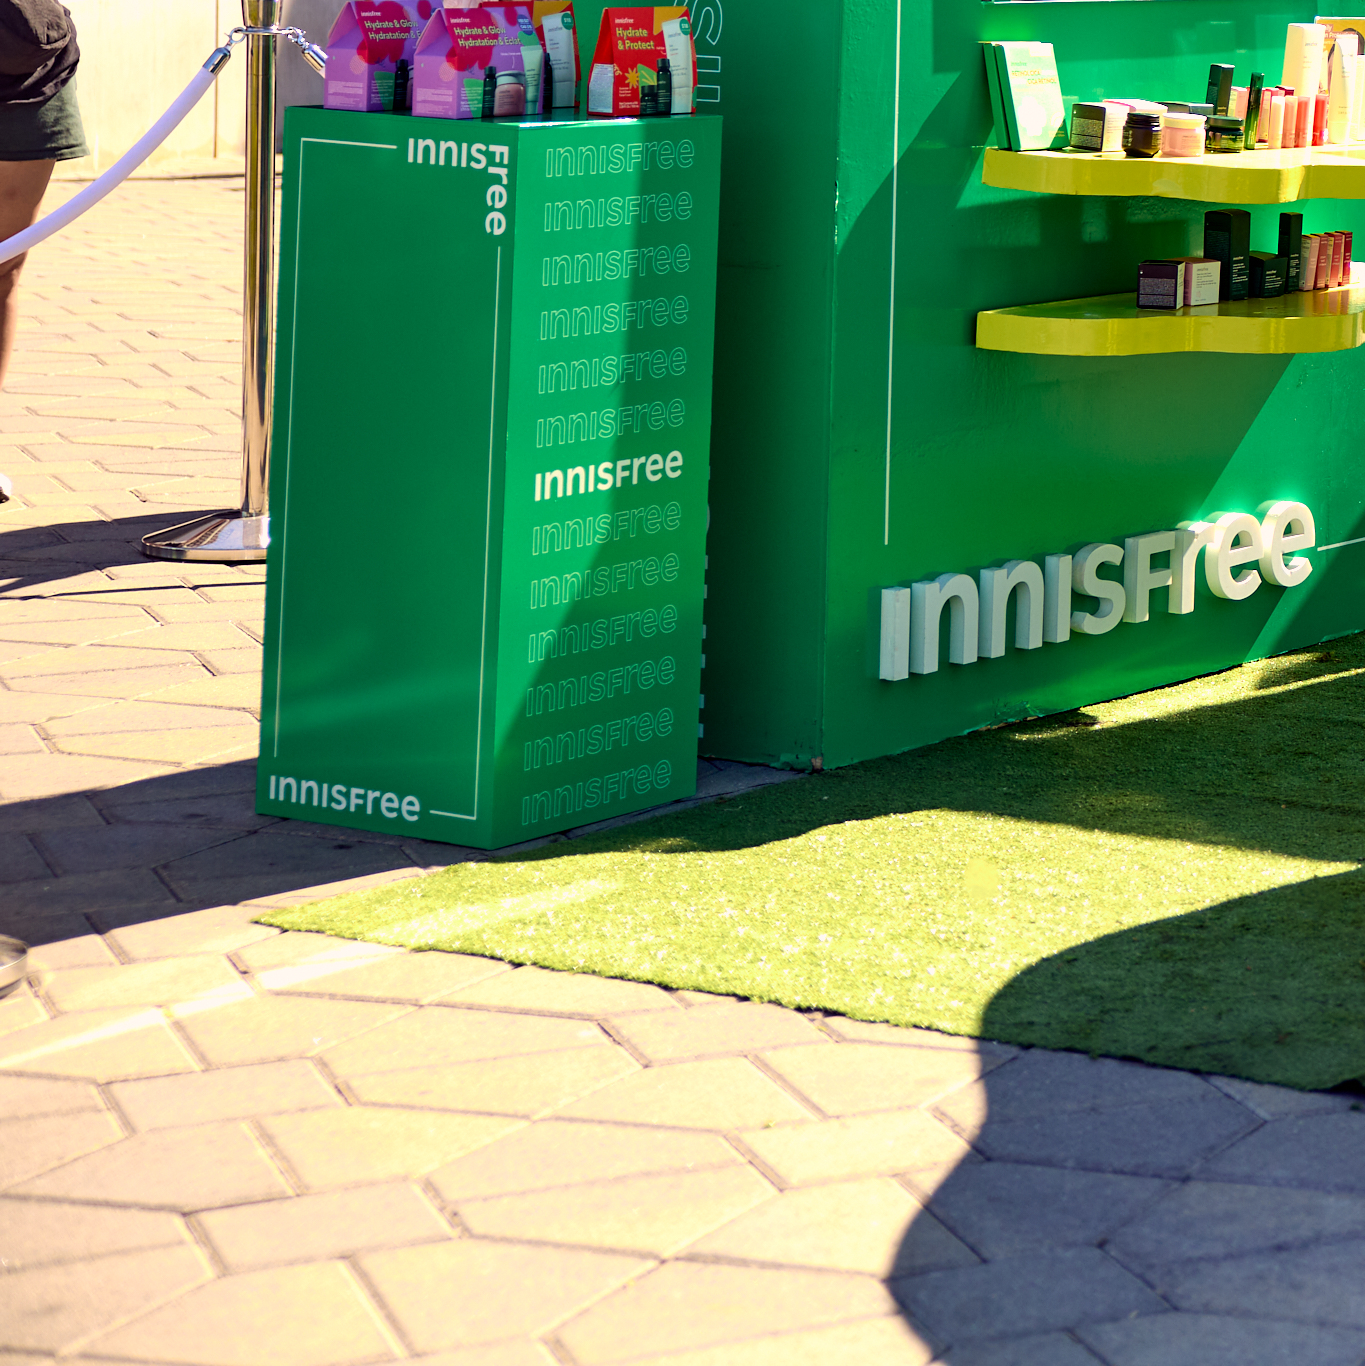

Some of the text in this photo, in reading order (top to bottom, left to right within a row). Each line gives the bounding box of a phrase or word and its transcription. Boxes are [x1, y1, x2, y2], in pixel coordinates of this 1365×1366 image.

[364, 19, 418, 31] Hydrate & Glow
[368, 30, 409, 42] Hydratation
[454, 26, 506, 37] Hydrate & Glow
[616, 27, 648, 39] Hydrate
[458, 37, 498, 49] Hydratation
[499, 37, 504, 45] &
[618, 40, 655, 50] & Protect
